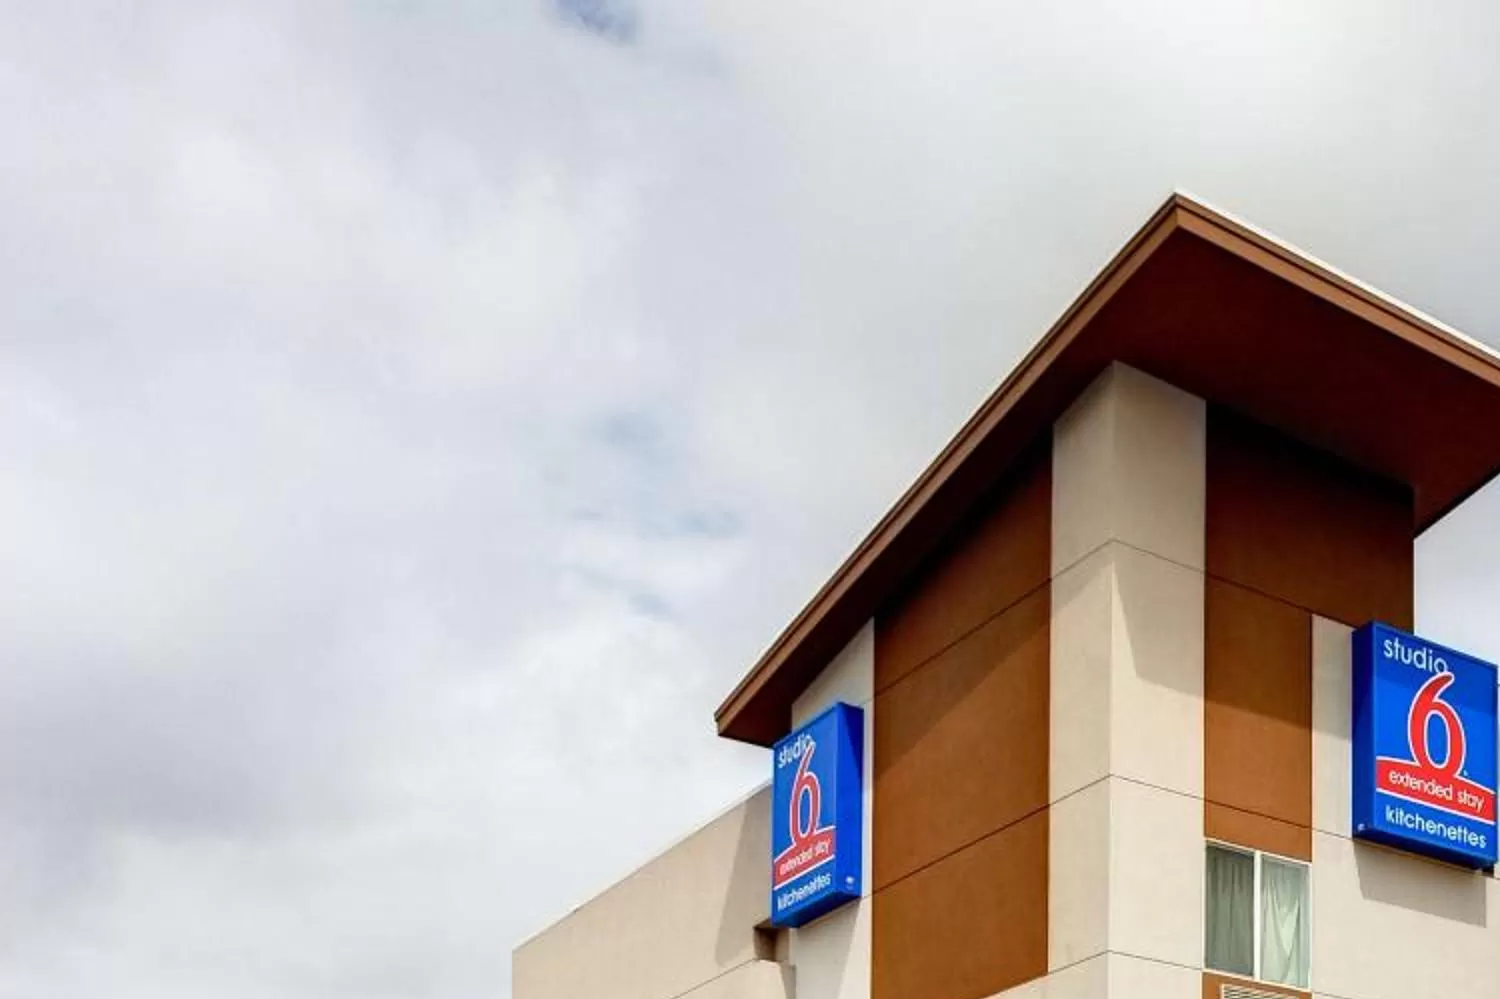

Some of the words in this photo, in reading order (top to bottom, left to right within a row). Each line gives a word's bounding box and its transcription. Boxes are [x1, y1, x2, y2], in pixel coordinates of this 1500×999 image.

[1383, 637, 1449, 674] studio
[1407, 671, 1467, 777] 6
[778, 732, 812, 768] studio
[789, 740, 821, 842] 6
[1388, 769, 1453, 801] extended
[1457, 789, 1485, 813] stay
[1385, 804, 1487, 849] kitchenettes
[777, 873, 831, 912] kitchenettes
